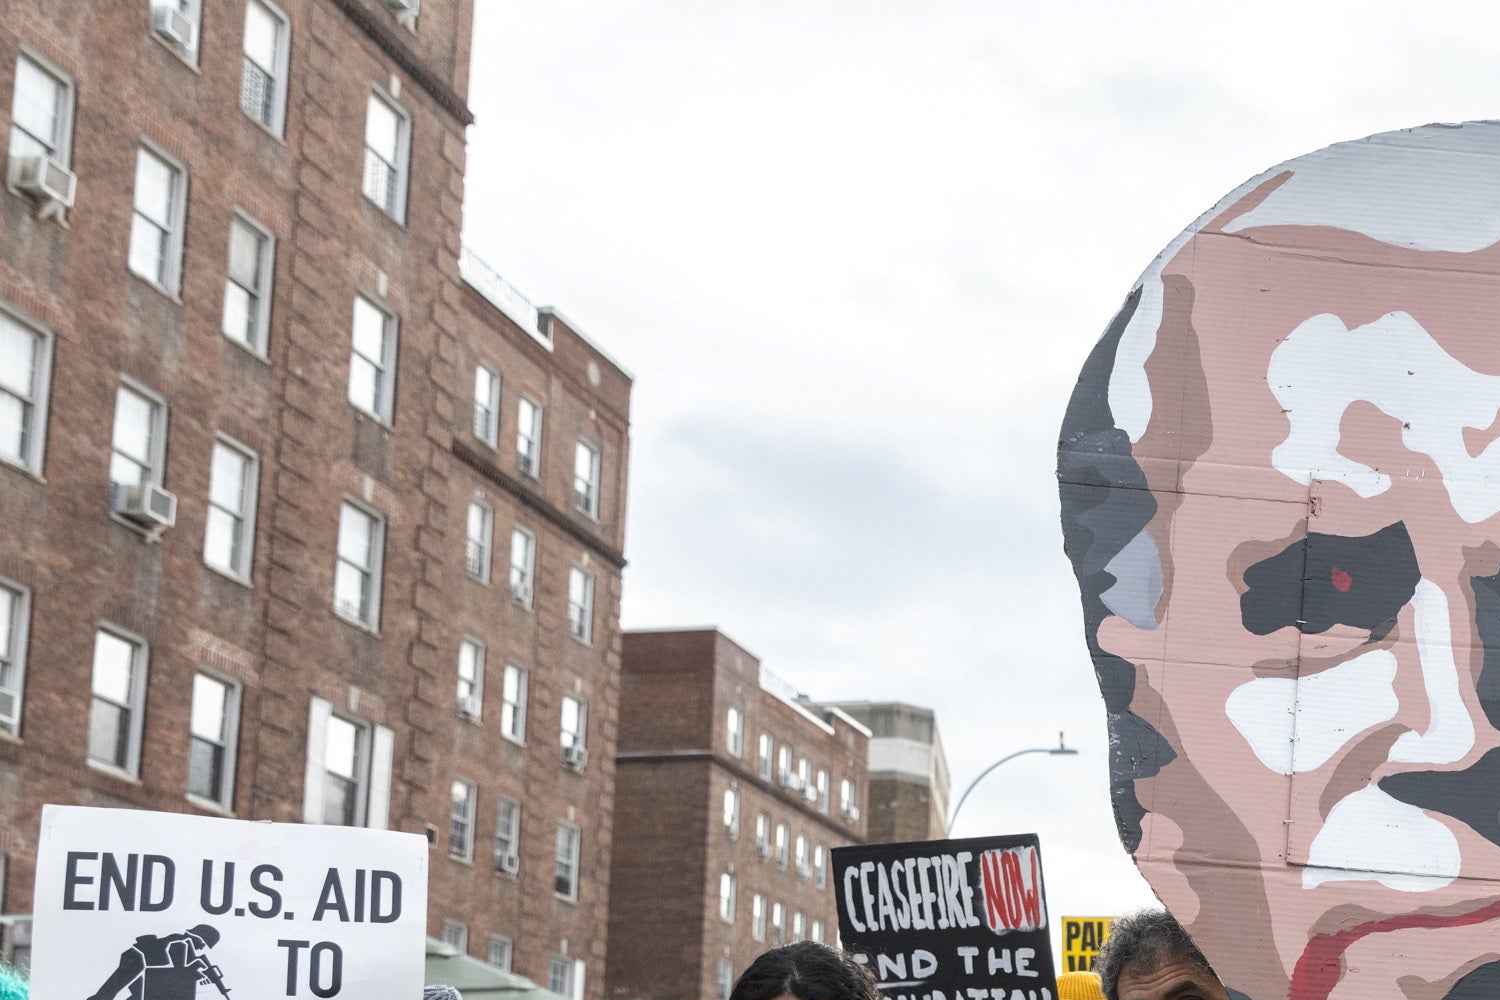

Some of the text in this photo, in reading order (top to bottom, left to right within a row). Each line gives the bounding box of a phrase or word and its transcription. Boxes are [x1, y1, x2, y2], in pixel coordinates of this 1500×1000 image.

[62, 851, 403, 924] END U.S. AID
[843, 846, 1042, 933] CEASEFIRE NOW
[277, 939, 344, 999] TO
[957, 946, 1039, 977] THE
